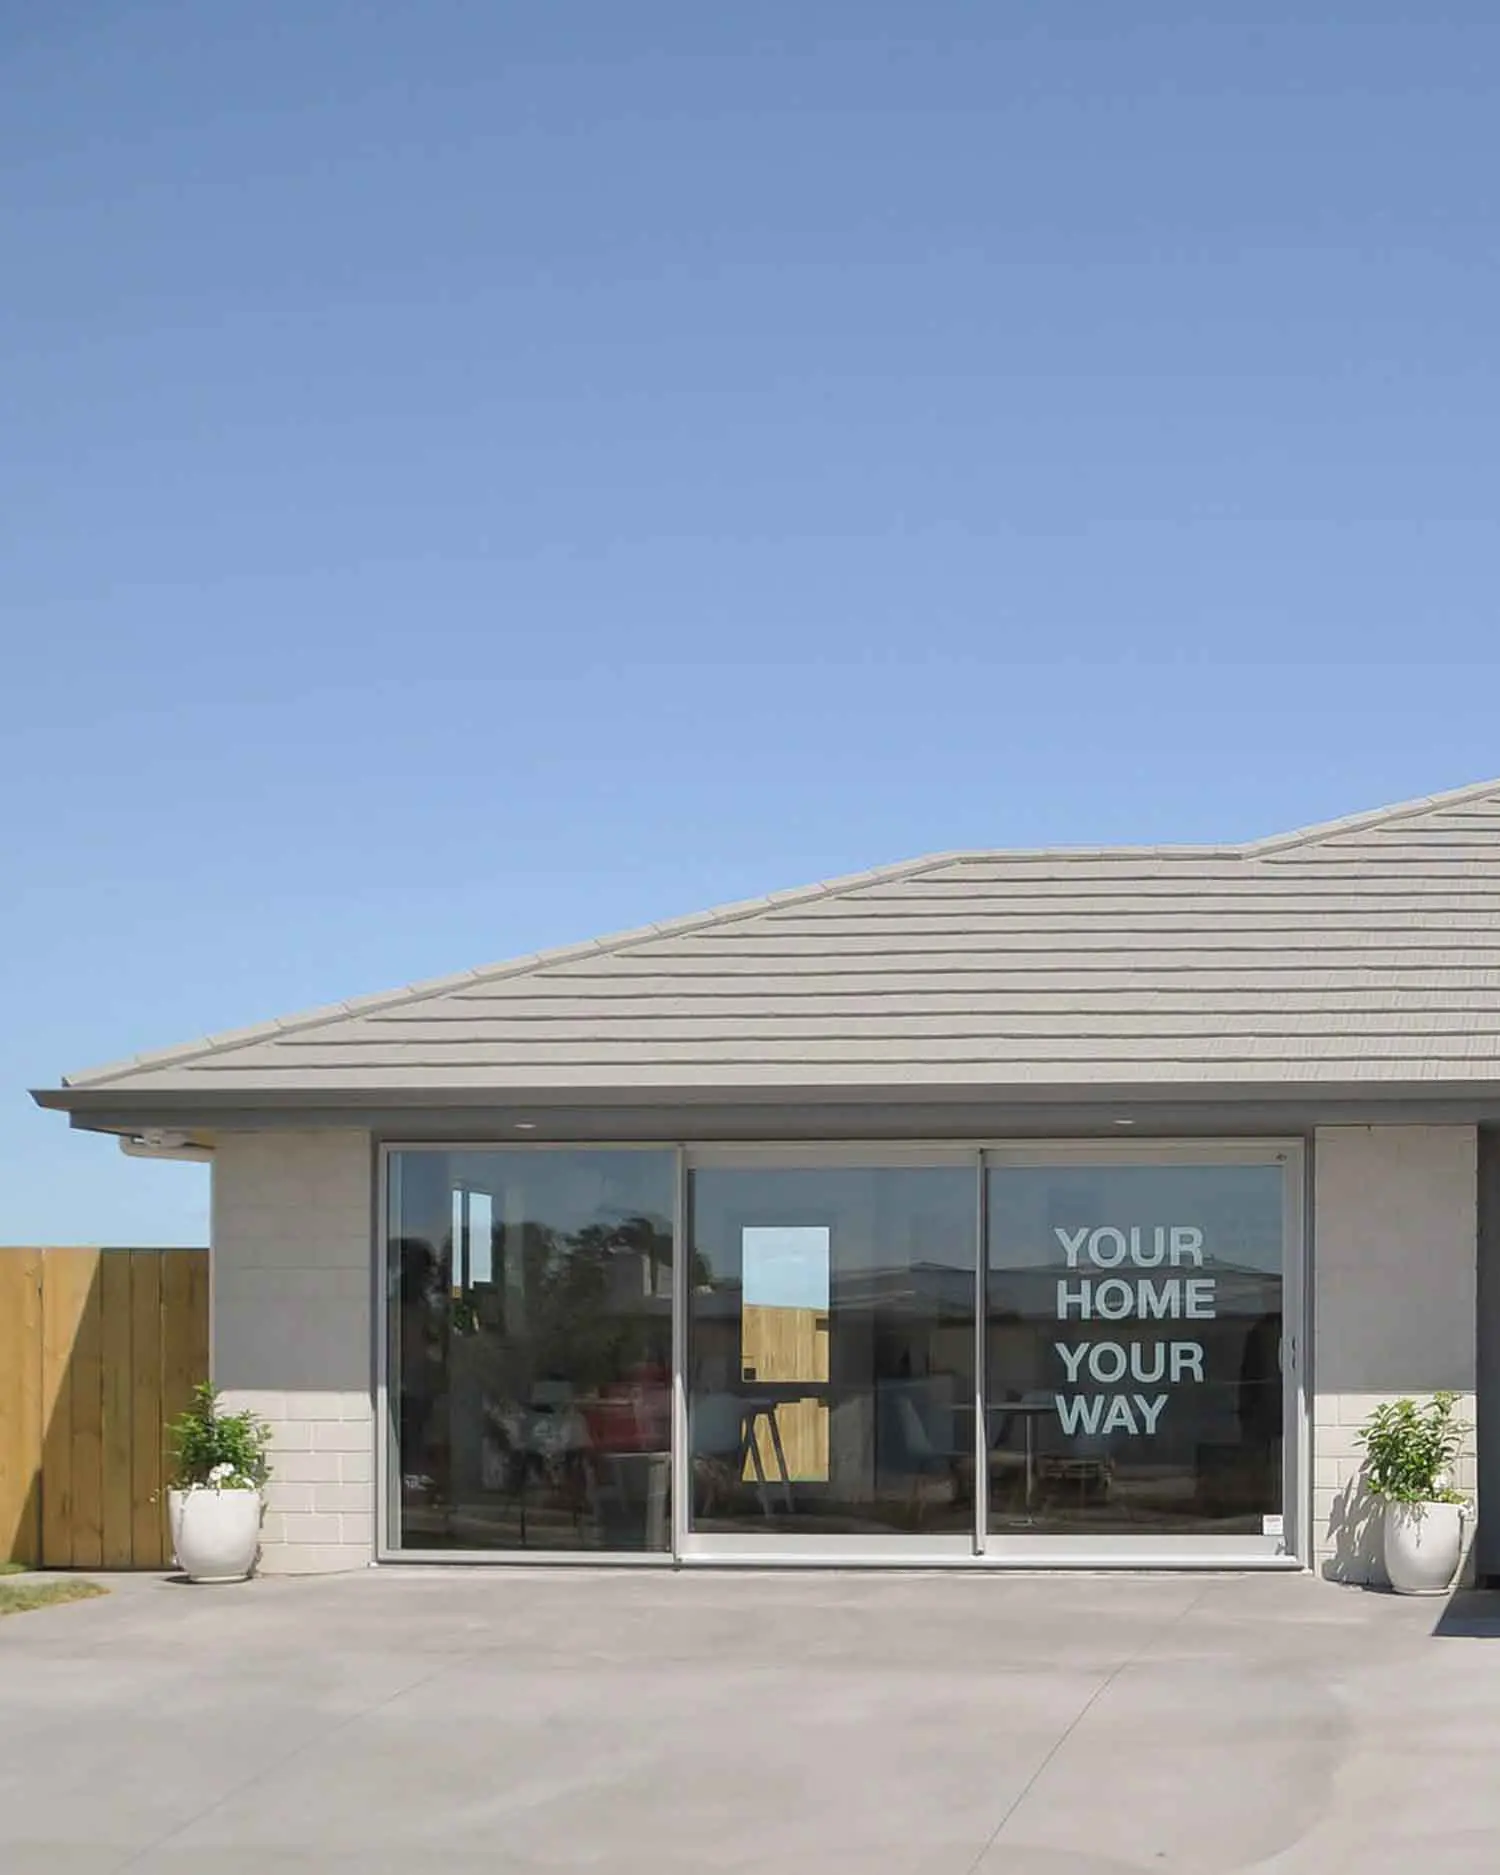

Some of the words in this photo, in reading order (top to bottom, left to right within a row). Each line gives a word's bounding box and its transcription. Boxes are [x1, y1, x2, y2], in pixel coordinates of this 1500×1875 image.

[1055, 1226, 1204, 1268] YOUR
[1056, 1279, 1217, 1320] HOME
[1055, 1341, 1205, 1383] YOUR
[1055, 1394, 1169, 1435] WAY
